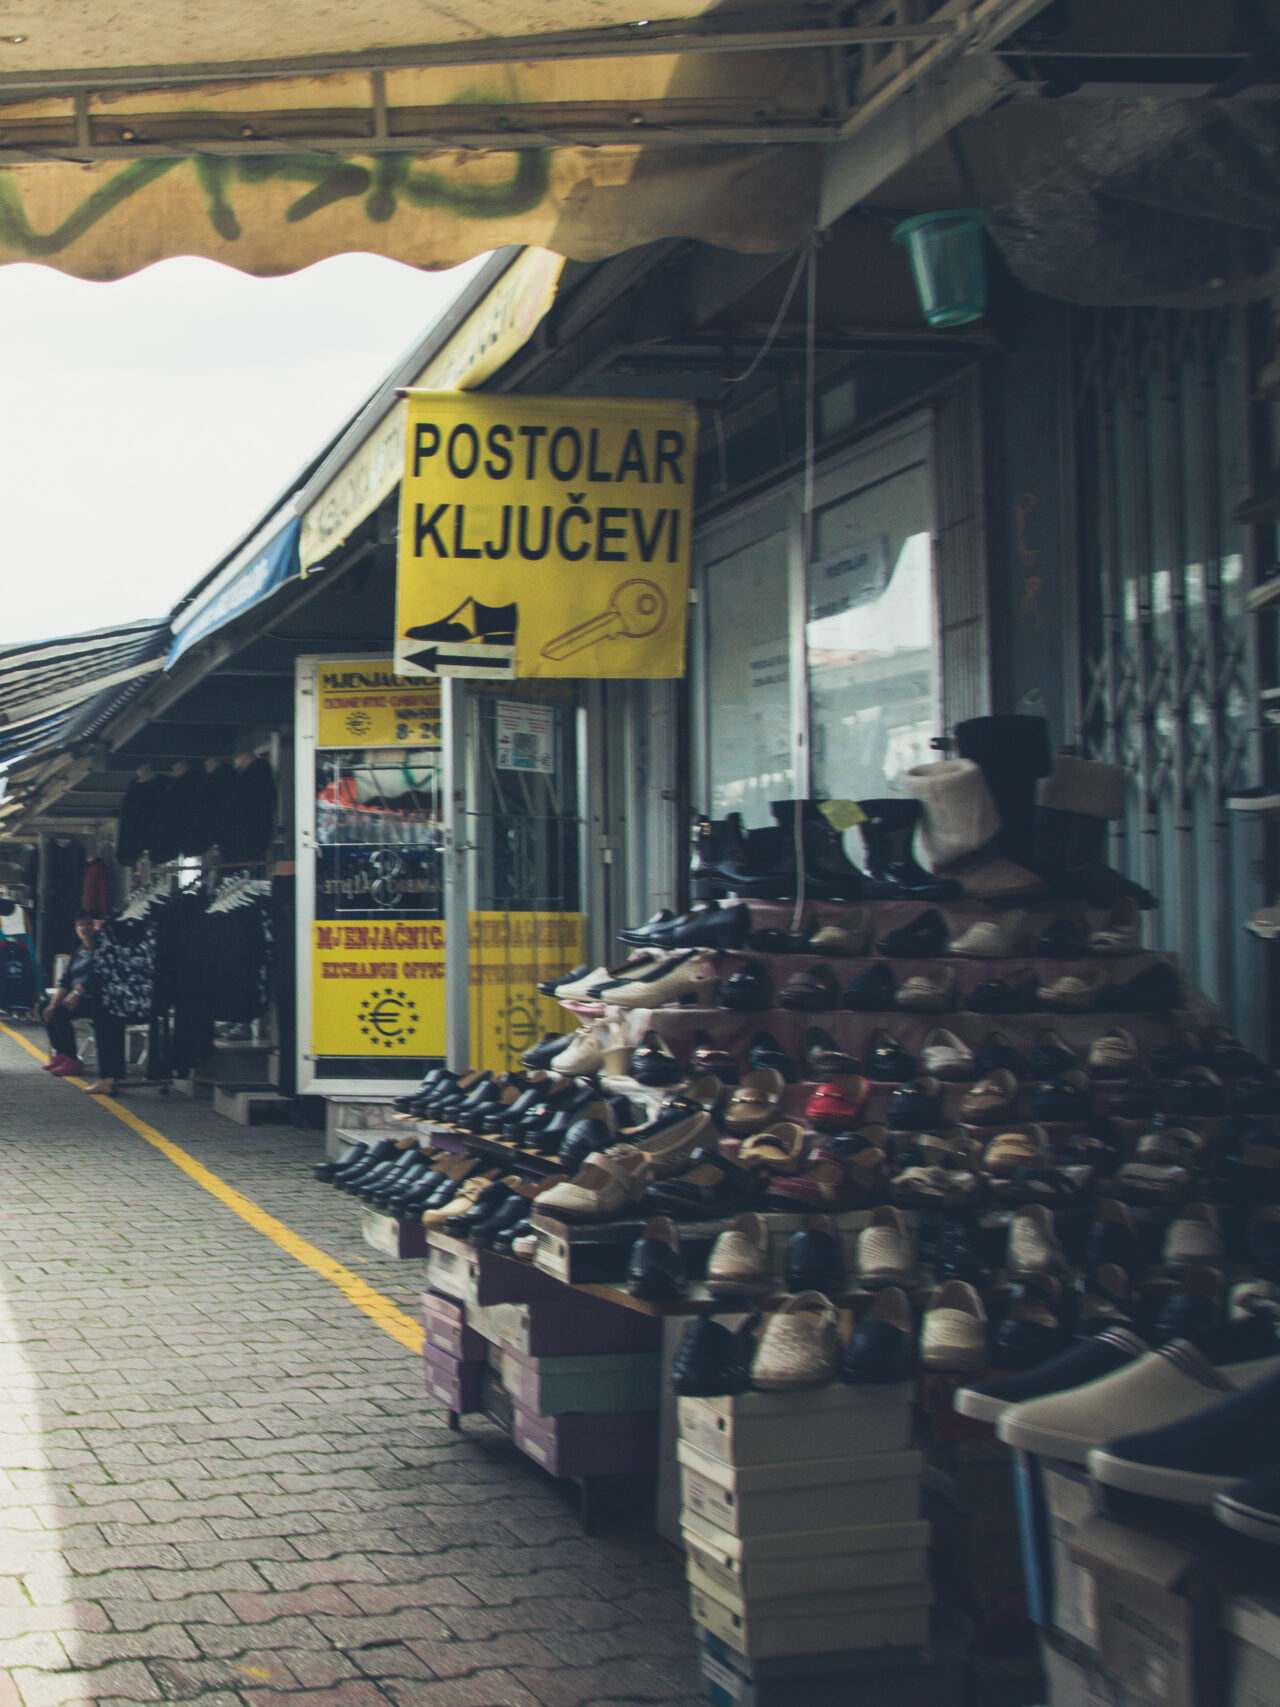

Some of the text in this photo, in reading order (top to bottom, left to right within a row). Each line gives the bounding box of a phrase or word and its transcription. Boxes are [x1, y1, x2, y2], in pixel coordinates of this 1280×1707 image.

[412, 422, 686, 485] POSTOLAR
[412, 492, 682, 563] KLJUČEVI
[316, 922, 447, 950] MJENJAČNIC
[402, 961, 447, 980] OFFIC
